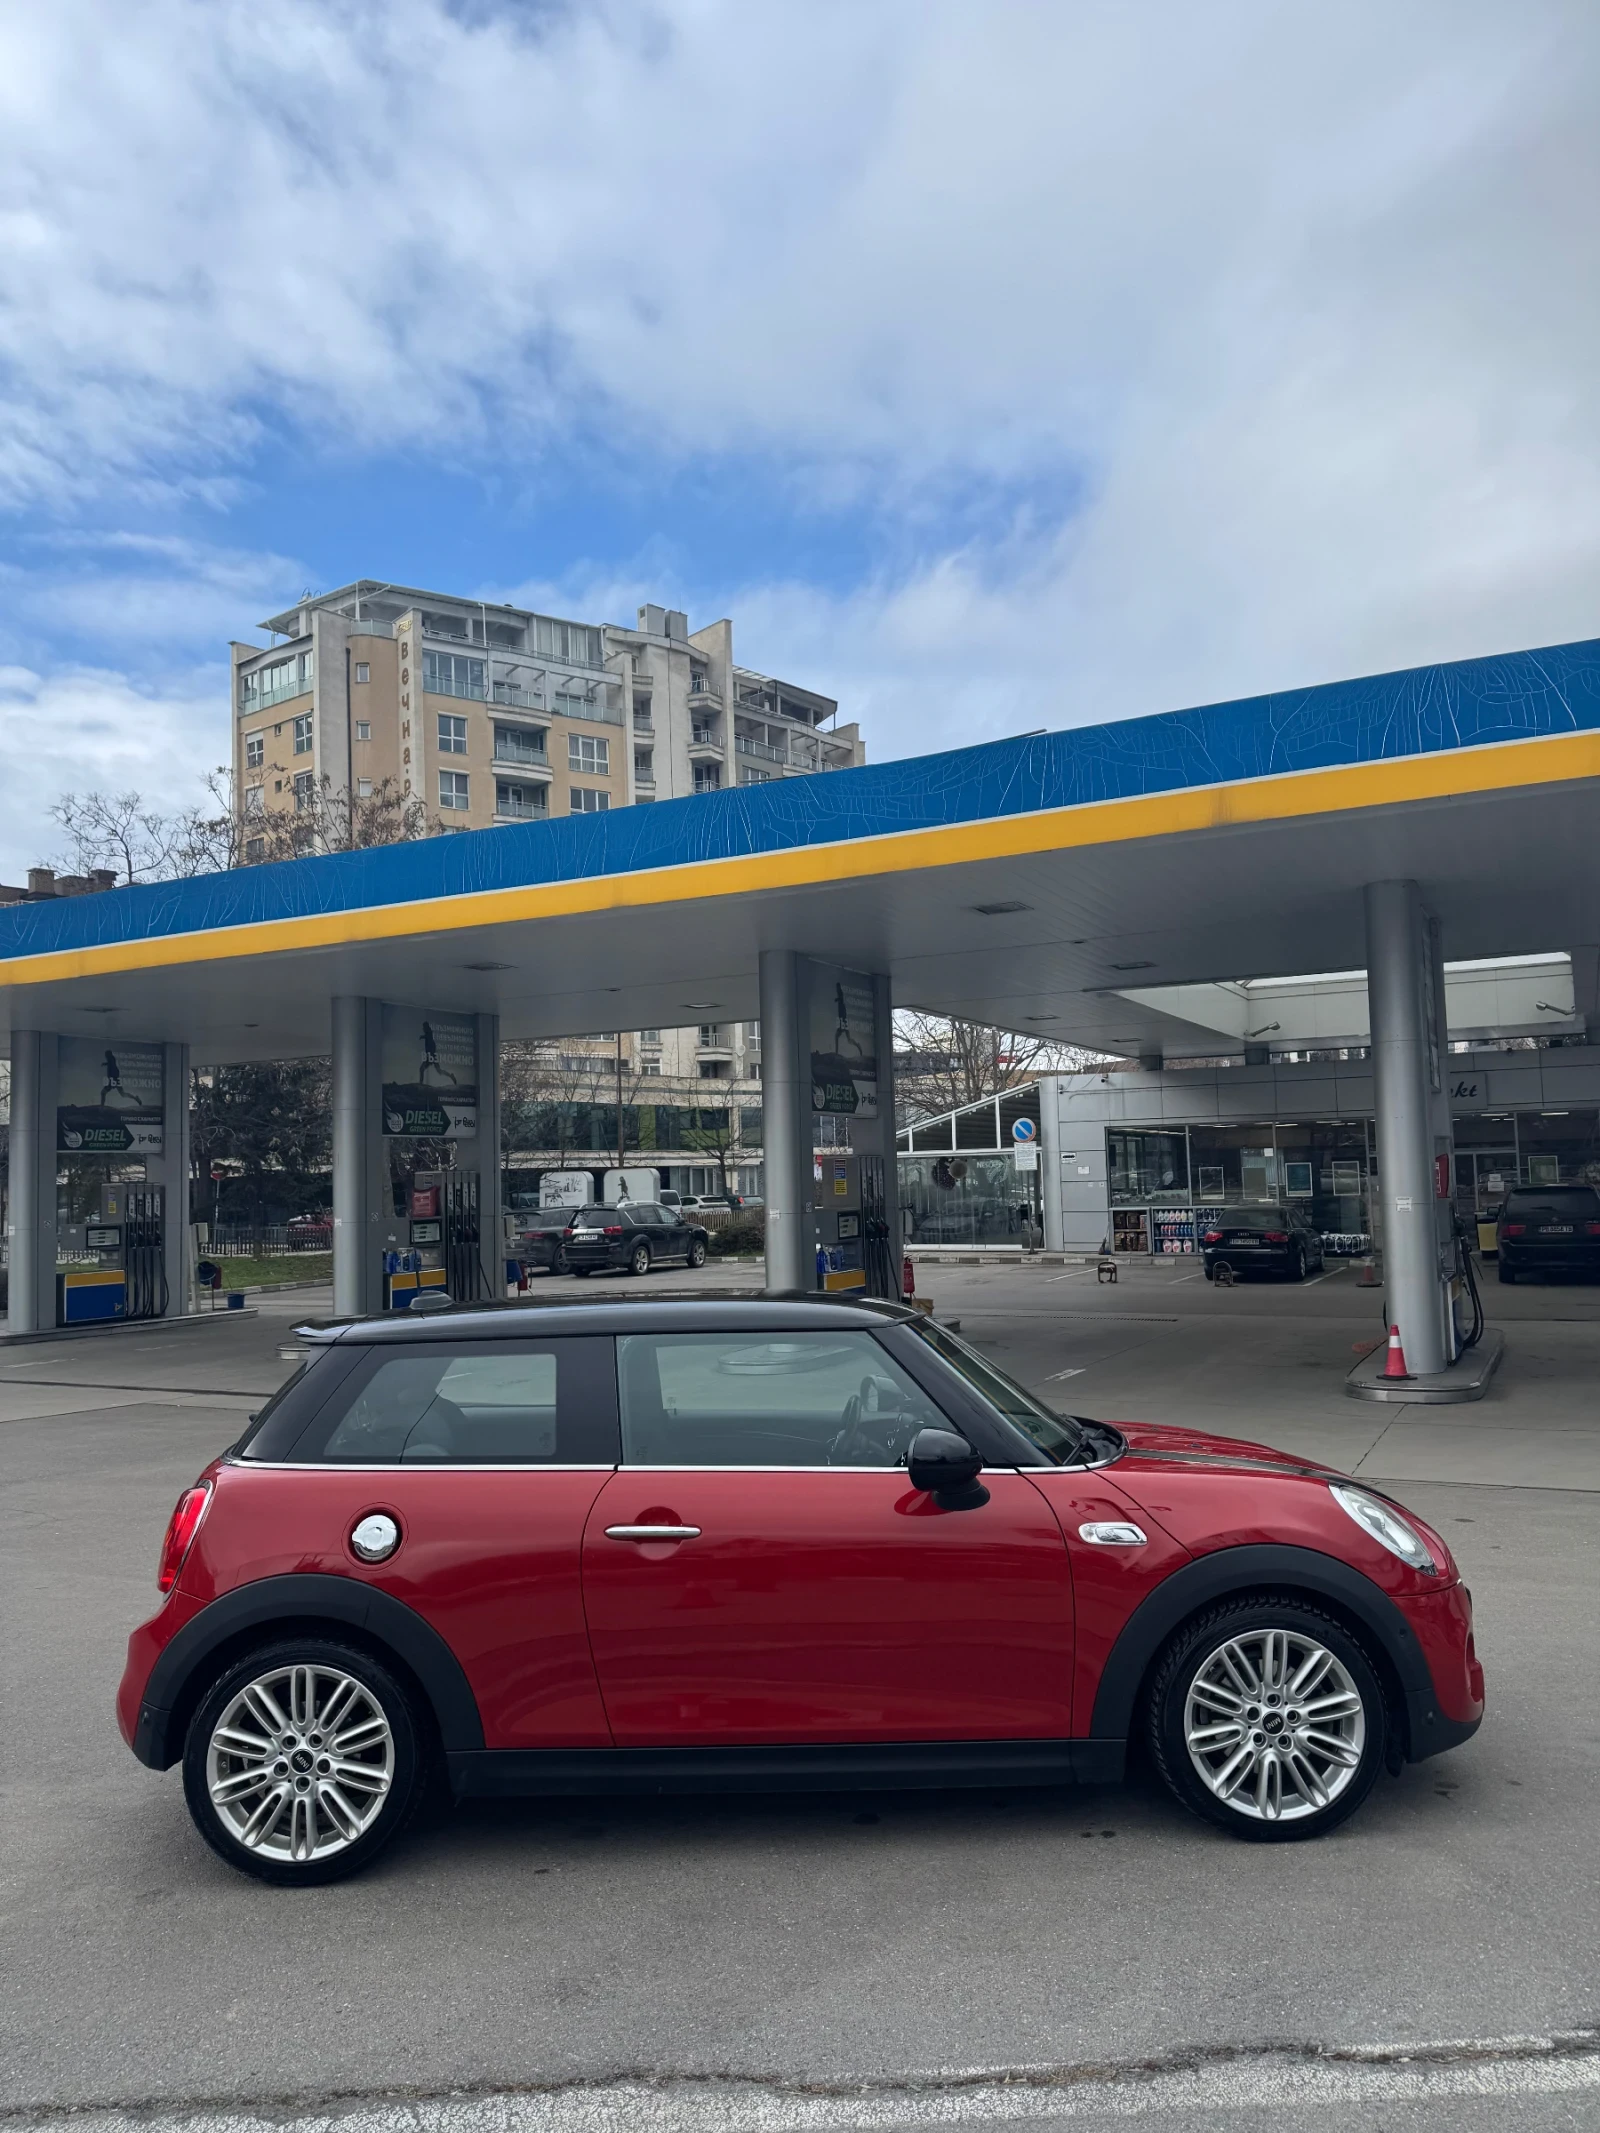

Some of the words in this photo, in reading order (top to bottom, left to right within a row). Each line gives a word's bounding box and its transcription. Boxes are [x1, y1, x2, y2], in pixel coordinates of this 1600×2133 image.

[421, 1052, 473, 1065] ВЪЗМОЖНО
[103, 1077, 161, 1088] ВЪЗМОЖНО
[405, 1109, 443, 1124] DIESEL
[84, 1128, 126, 1142] DIESEL
[1265, 1717, 1281, 1730] MINI
[295, 1753, 310, 1769] MINI
